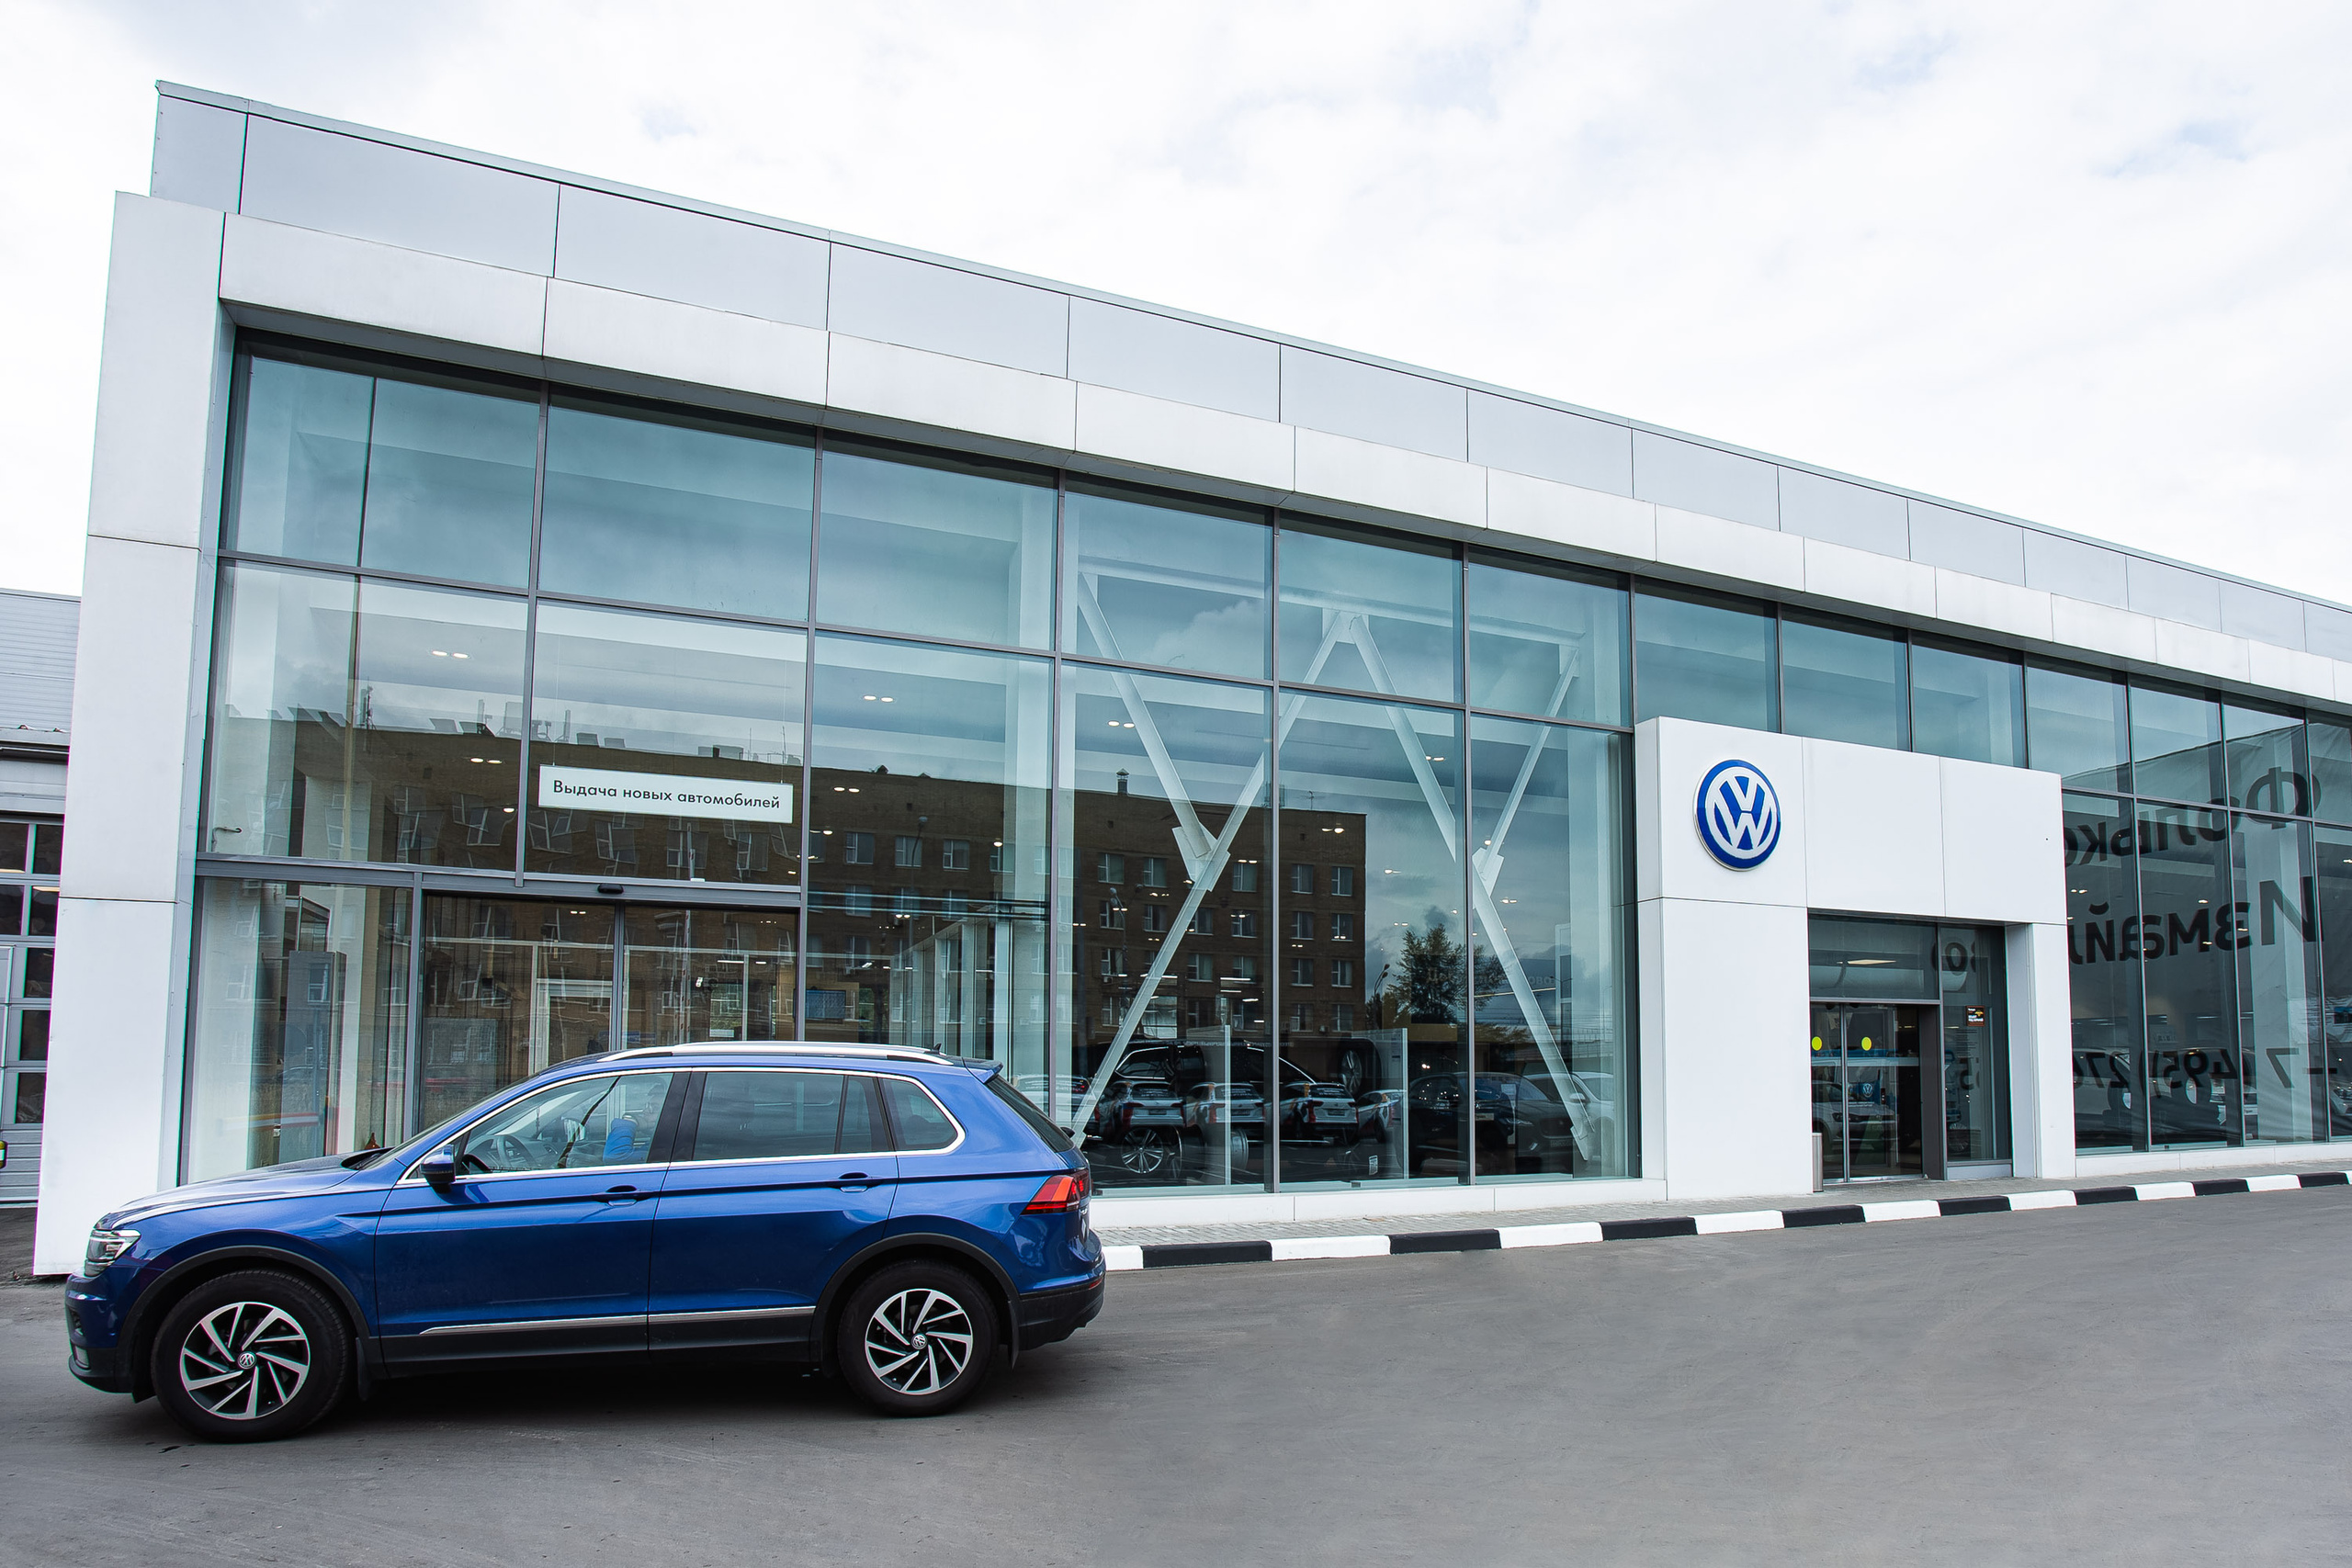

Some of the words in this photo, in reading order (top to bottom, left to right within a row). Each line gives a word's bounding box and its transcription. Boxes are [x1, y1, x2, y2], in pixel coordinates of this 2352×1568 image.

[553, 779, 617, 797] Выдача
[622, 788, 673, 802] новых
[677, 792, 781, 809] автомобилей
[1704, 766, 1778, 860] VW
